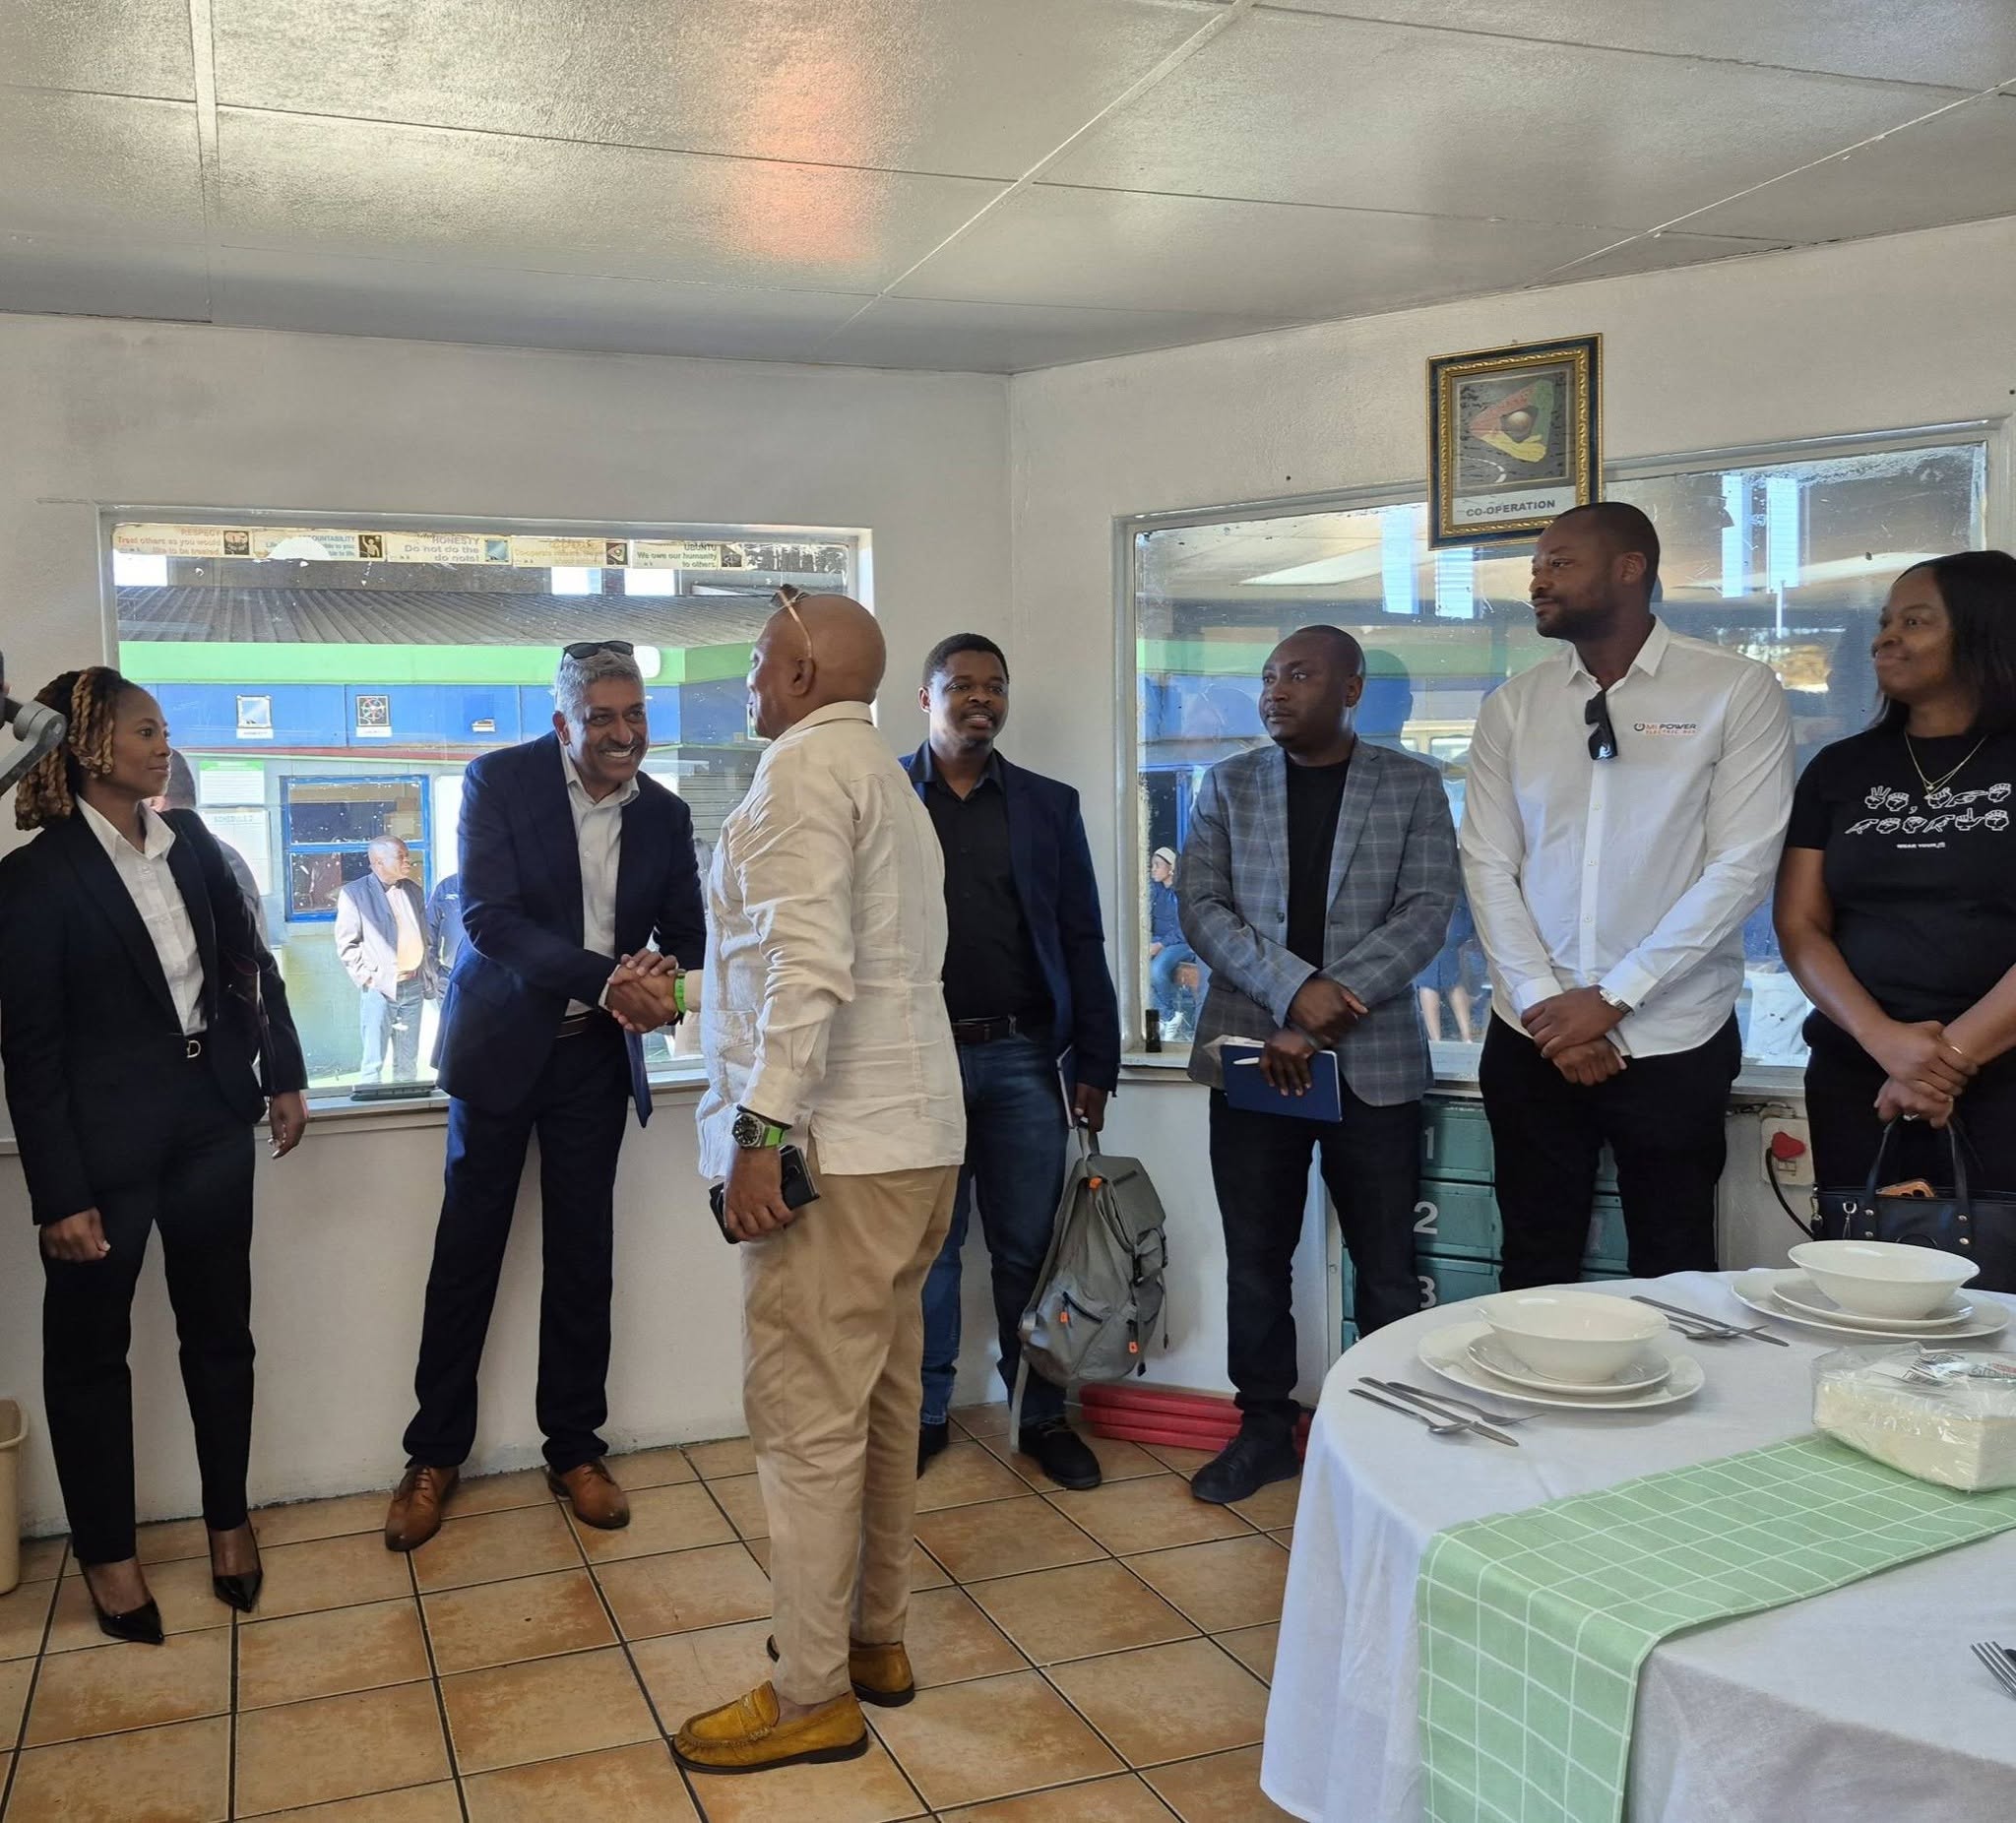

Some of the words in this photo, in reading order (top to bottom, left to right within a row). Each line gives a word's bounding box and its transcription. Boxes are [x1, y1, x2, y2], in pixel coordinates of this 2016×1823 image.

[1467, 500, 1555, 517] CO-OPERATION
[180, 528, 222, 537] RESPECT
[431, 535, 480, 544] HONESTY
[683, 551, 717, 561] humanity
[1424, 1126, 1435, 1160] 1
[1414, 1201, 1438, 1234] 2
[1418, 1275, 1437, 1308] 3
